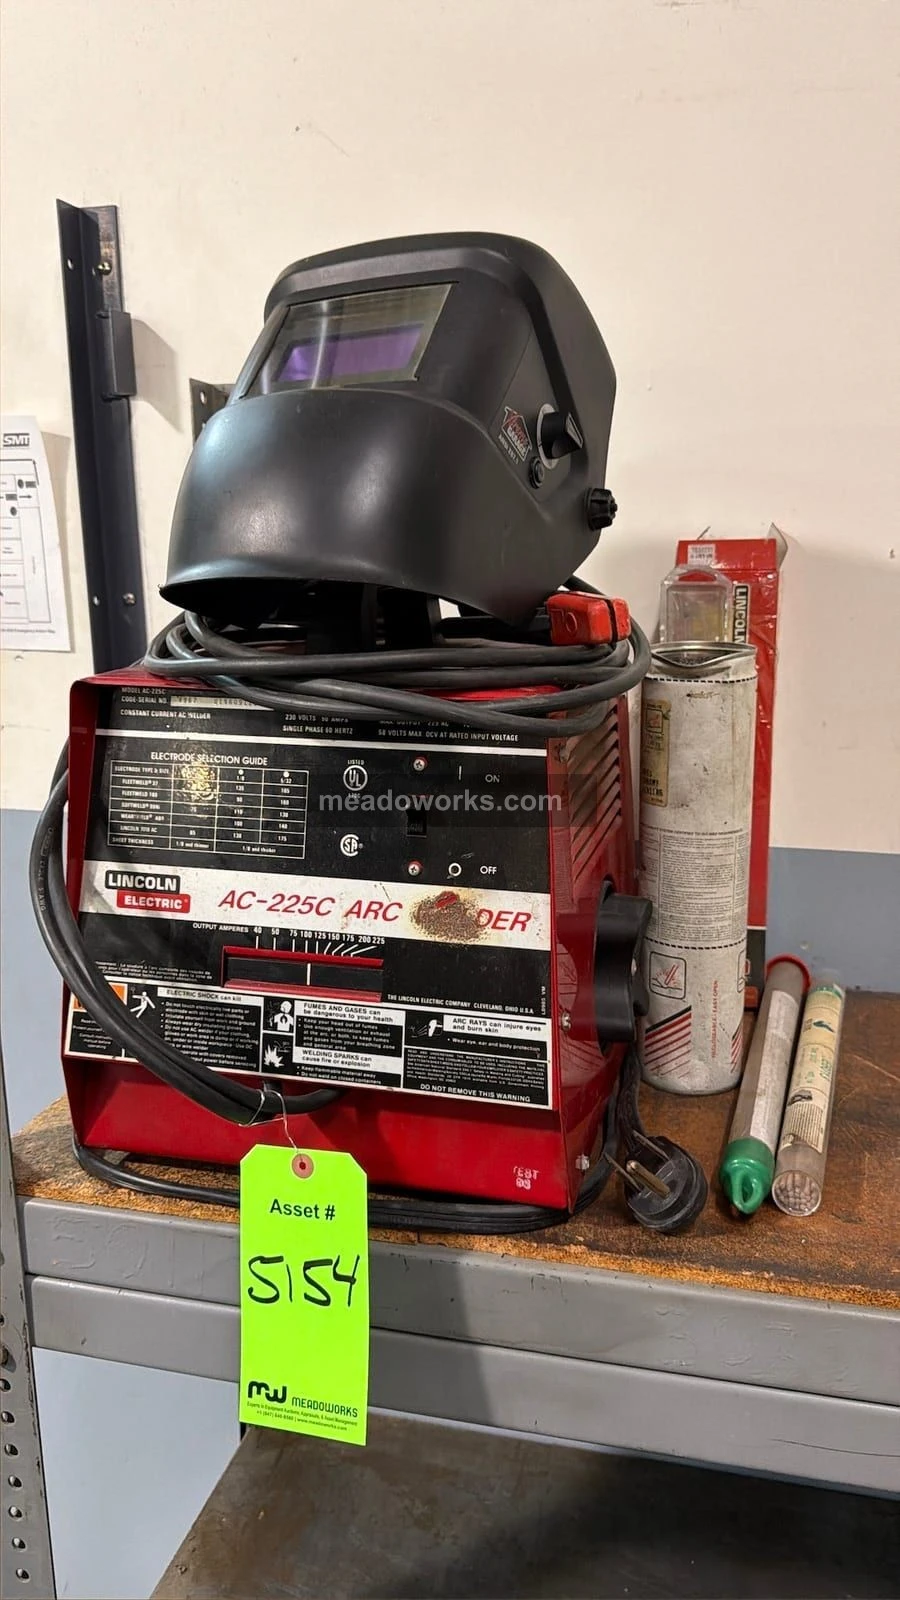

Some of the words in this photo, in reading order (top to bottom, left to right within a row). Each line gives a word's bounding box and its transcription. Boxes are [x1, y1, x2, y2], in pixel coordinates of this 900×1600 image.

[4, 434, 30, 446] SMT
[120, 709, 149, 717] CONSTANT
[298, 714, 316, 722] VOLTS
[388, 729, 407, 737] VOLTS
[150, 751, 195, 762] ELECTRODE
[196, 754, 240, 764] SELECTION
[242, 756, 267, 766] GUIDE
[486, 774, 500, 782] ON
[480, 865, 497, 874] OFF
[108, 874, 177, 891] LINCOLN
[124, 895, 182, 909] ELECTRIC
[218, 890, 336, 916] AC-225C
[344, 899, 403, 922] ARC
[193, 922, 217, 930] OUTPUT
[219, 924, 249, 933] AMPERES
[253, 926, 262, 934] 40
[289, 929, 297, 937] 75
[300, 930, 312, 938] 100
[315, 931, 326, 939] 125
[328, 932, 340, 940] 150
[342, 934, 354, 942] 175
[358, 935, 371, 943] 200
[372, 936, 385, 944] 225
[166, 989, 196, 998] ELECTRIC
[198, 992, 219, 1000] SHOCK
[304, 1002, 326, 1010] FUMES
[345, 1006, 366, 1014] GASES
[398, 995, 420, 1003] LINCOLN
[421, 997, 444, 1006] ELECTRIC
[445, 999, 471, 1008] COMPANY
[505, 1005, 518, 1013] OHIO
[314, 1010, 346, 1018] dangerous
[513, 1044, 540, 1052] protection
[302, 1049, 332, 1058] WELDING
[334, 1052, 359, 1060] SPARKS
[341, 1059, 370, 1067] explosion
[432, 1085, 446, 1093] NOT
[448, 1087, 477, 1097] REMOVE
[478, 1091, 494, 1099] THIS
[496, 1093, 530, 1103] WARNING
[270, 1199, 320, 1219] Asset
[325, 1204, 336, 1221] #
[248, 1254, 360, 1307] 5154
[291, 1396, 358, 1418] MEADOWORKS
